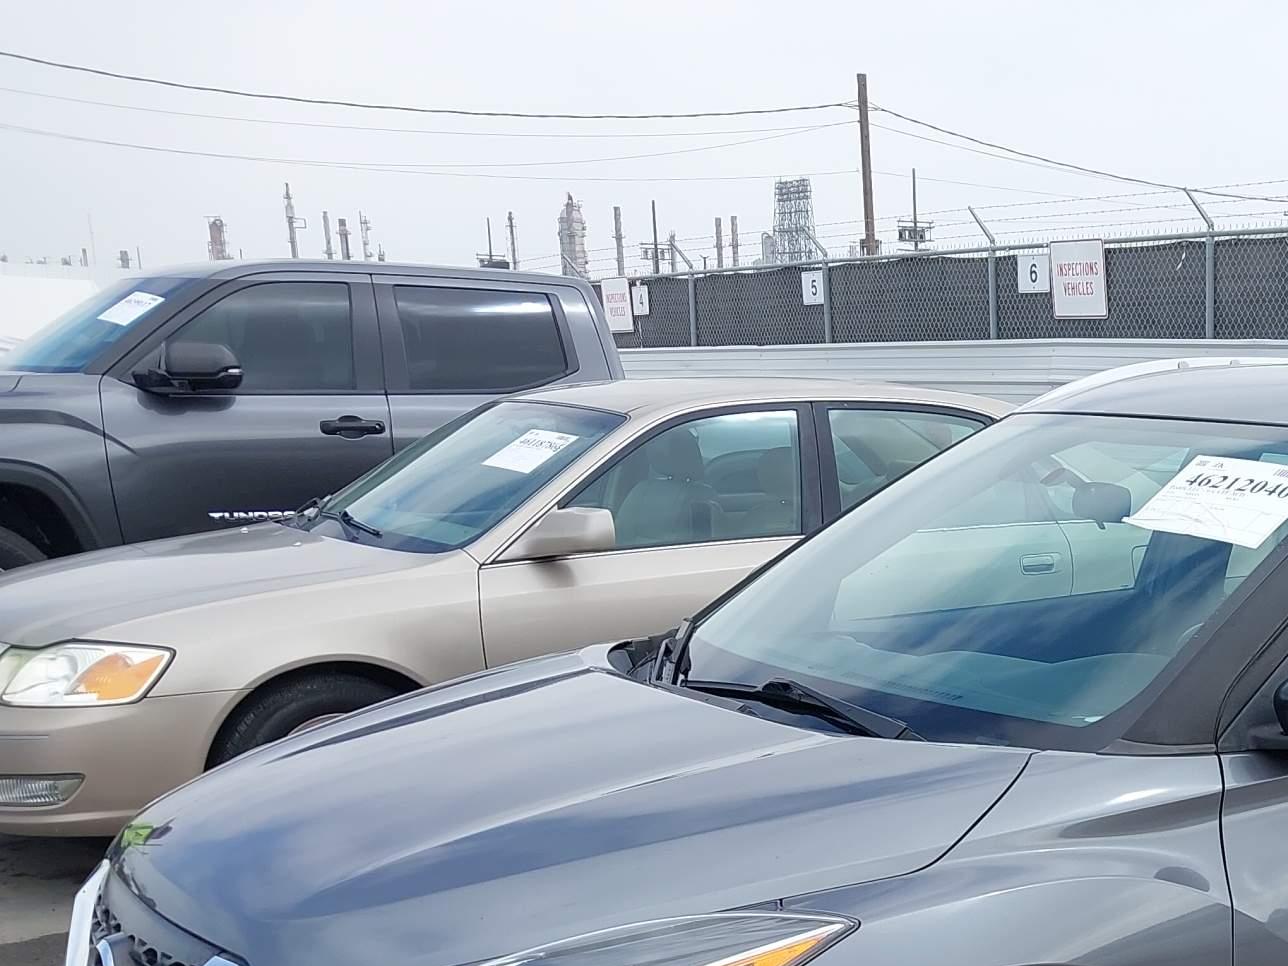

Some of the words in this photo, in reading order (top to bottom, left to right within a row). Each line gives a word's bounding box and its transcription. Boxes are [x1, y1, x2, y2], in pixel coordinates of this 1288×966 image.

[1029, 263, 1038, 283] 6
[1056, 262, 1099, 277] INSPECTIONS
[811, 279, 818, 296] 5
[1063, 281, 1094, 297] VEHICLES
